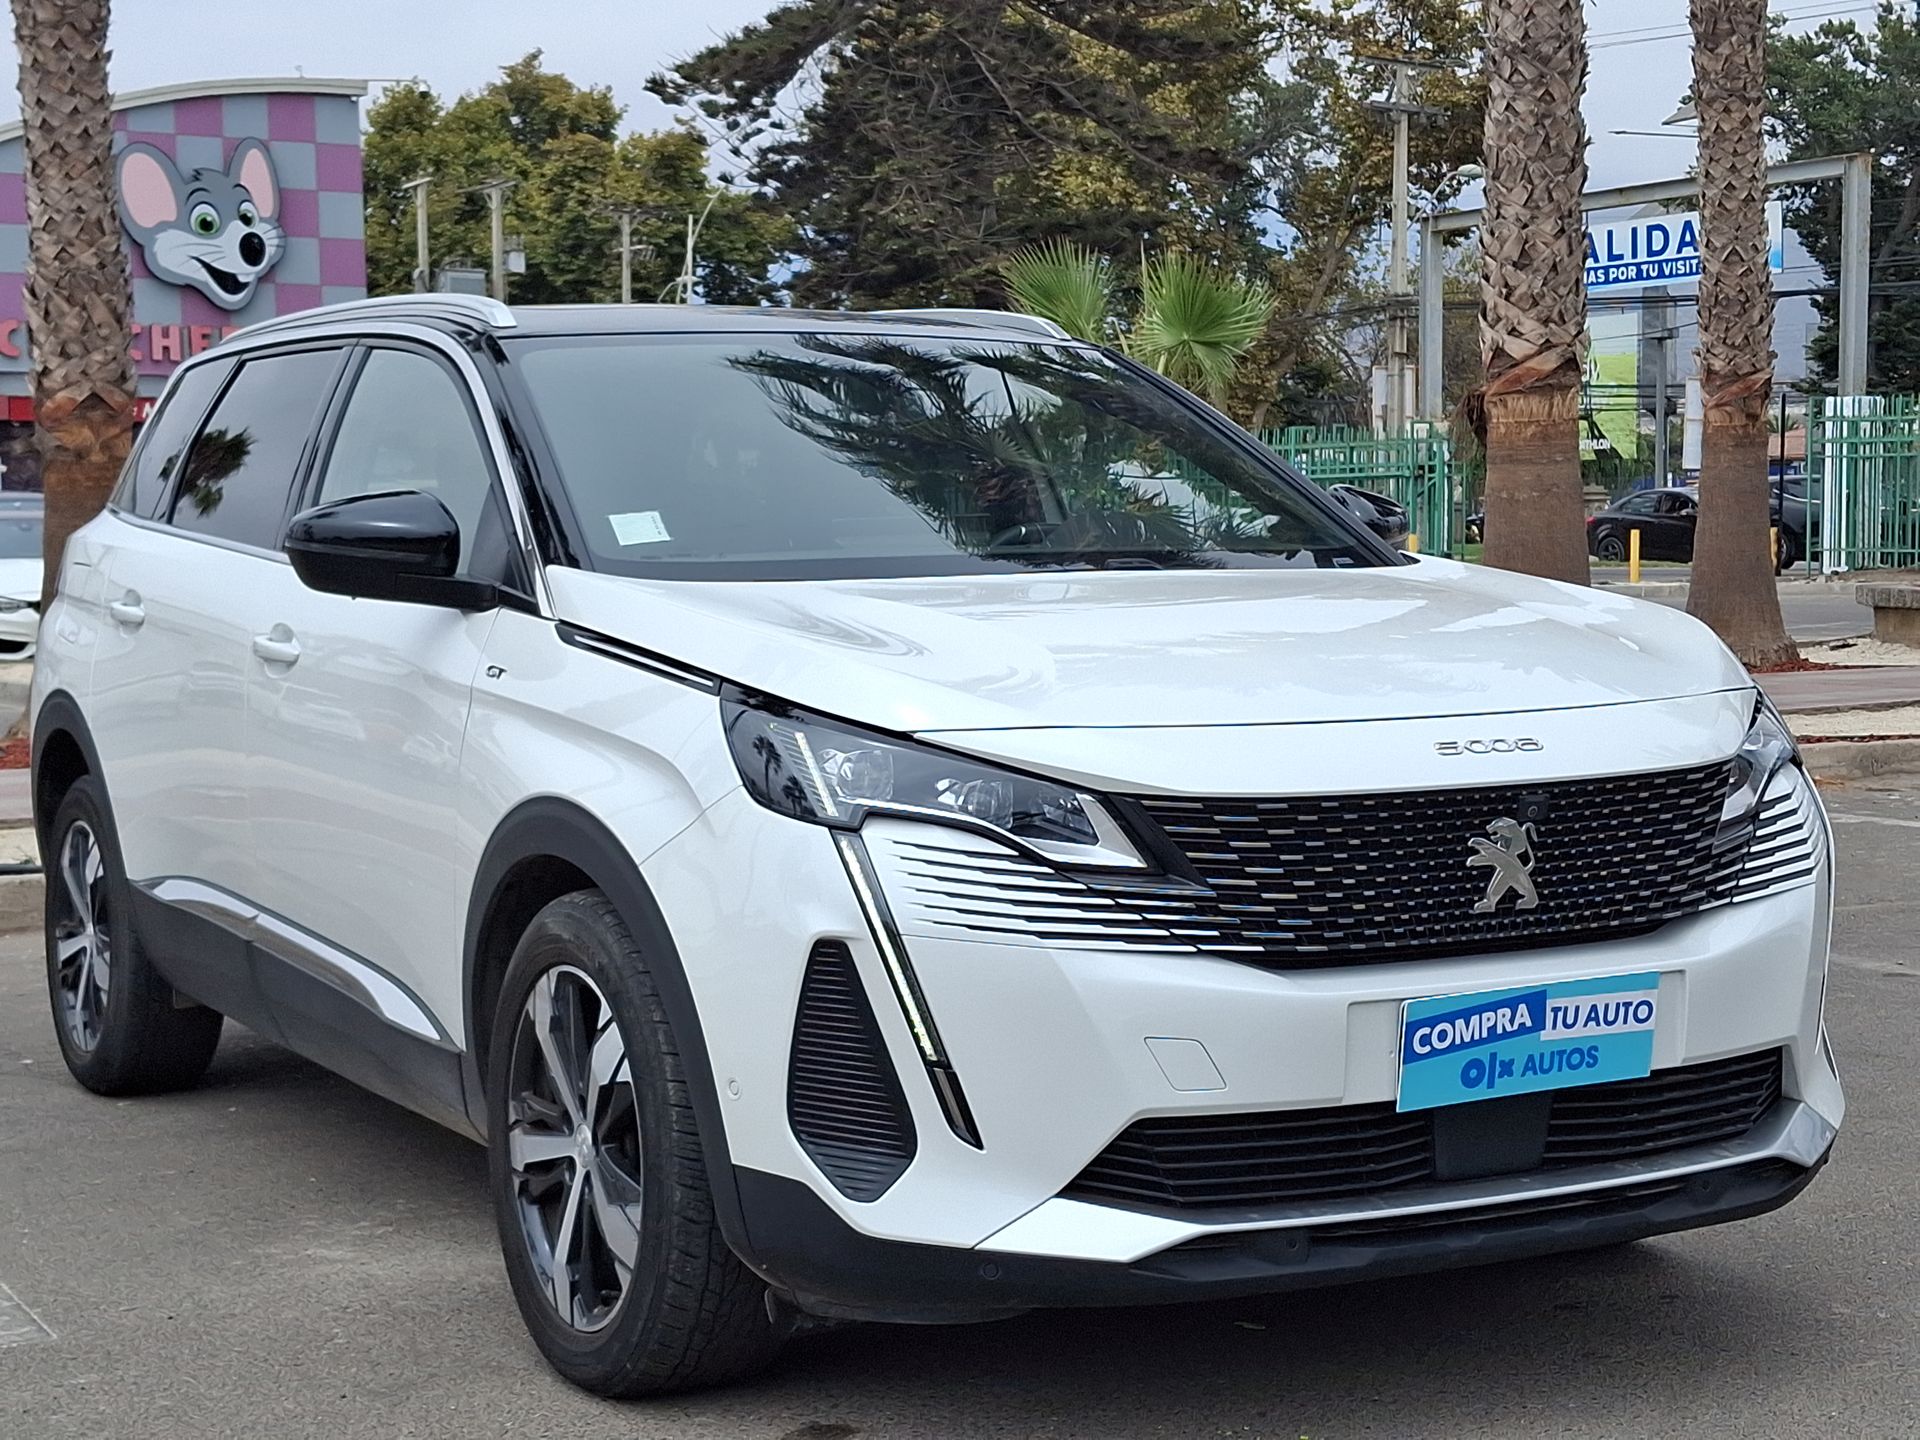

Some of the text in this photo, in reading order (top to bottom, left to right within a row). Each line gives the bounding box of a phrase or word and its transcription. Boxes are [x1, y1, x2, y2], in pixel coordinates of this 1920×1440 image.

[1609, 265, 1637, 282] POR
[1641, 263, 1659, 279] TU
[1662, 258, 1702, 276] VISIT
[486, 665, 507, 680] GT
[1412, 999, 1655, 1055] COMPRA TU AUTO
[1520, 1045, 1600, 1079] AUTOS
